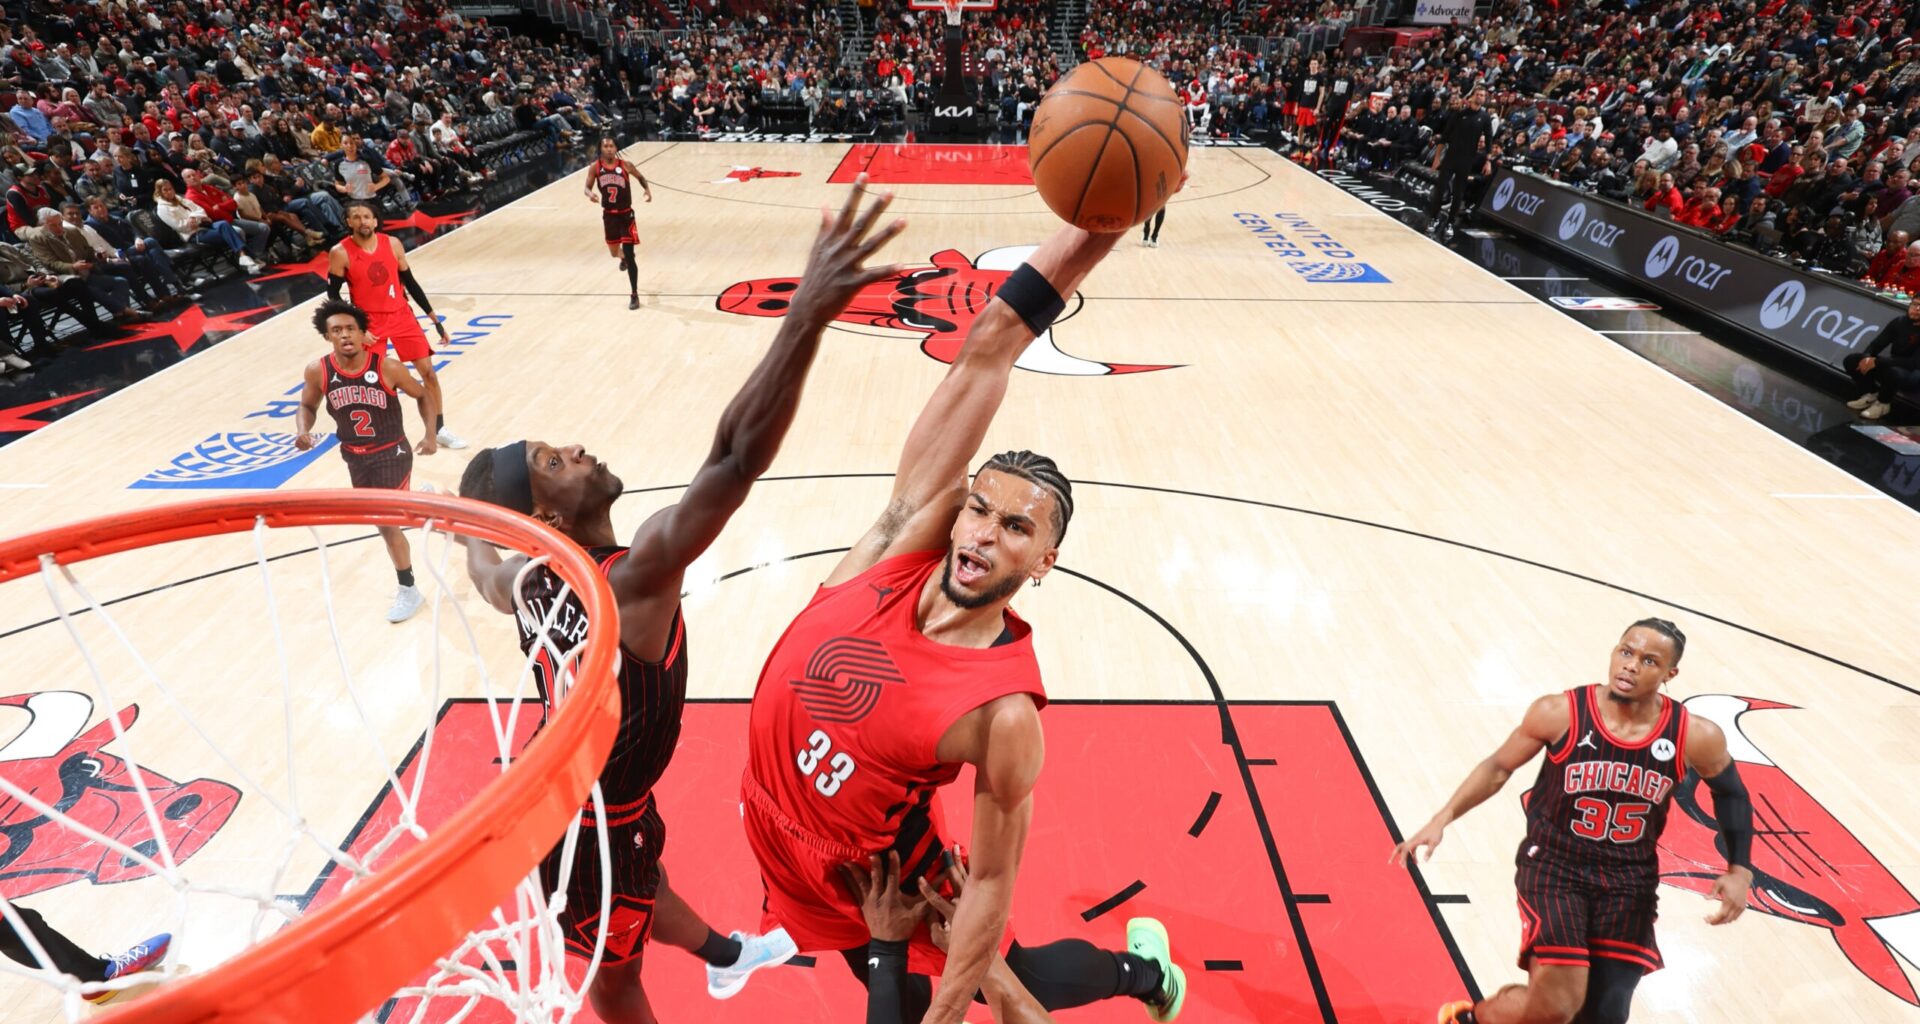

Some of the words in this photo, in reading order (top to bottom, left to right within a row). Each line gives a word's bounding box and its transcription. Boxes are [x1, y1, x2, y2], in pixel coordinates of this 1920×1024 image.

[1428, 4, 1470, 17] Advocate
[934, 105, 973, 118] KIA
[607, 186, 618, 203] 7
[1510, 191, 1545, 217] razr
[1232, 212, 1307, 258] CENTER
[1274, 212, 1356, 259] UNITED
[1582, 218, 1626, 249] razr
[1674, 255, 1732, 291] razr
[388, 283, 396, 299] 4
[1801, 305, 1880, 349] razr
[328, 385, 388, 410] CHICAGO
[350, 410, 376, 437] 2
[796, 728, 857, 798] 33
[1566, 761, 1673, 805] CHICAGO
[1571, 796, 1650, 843] 35
